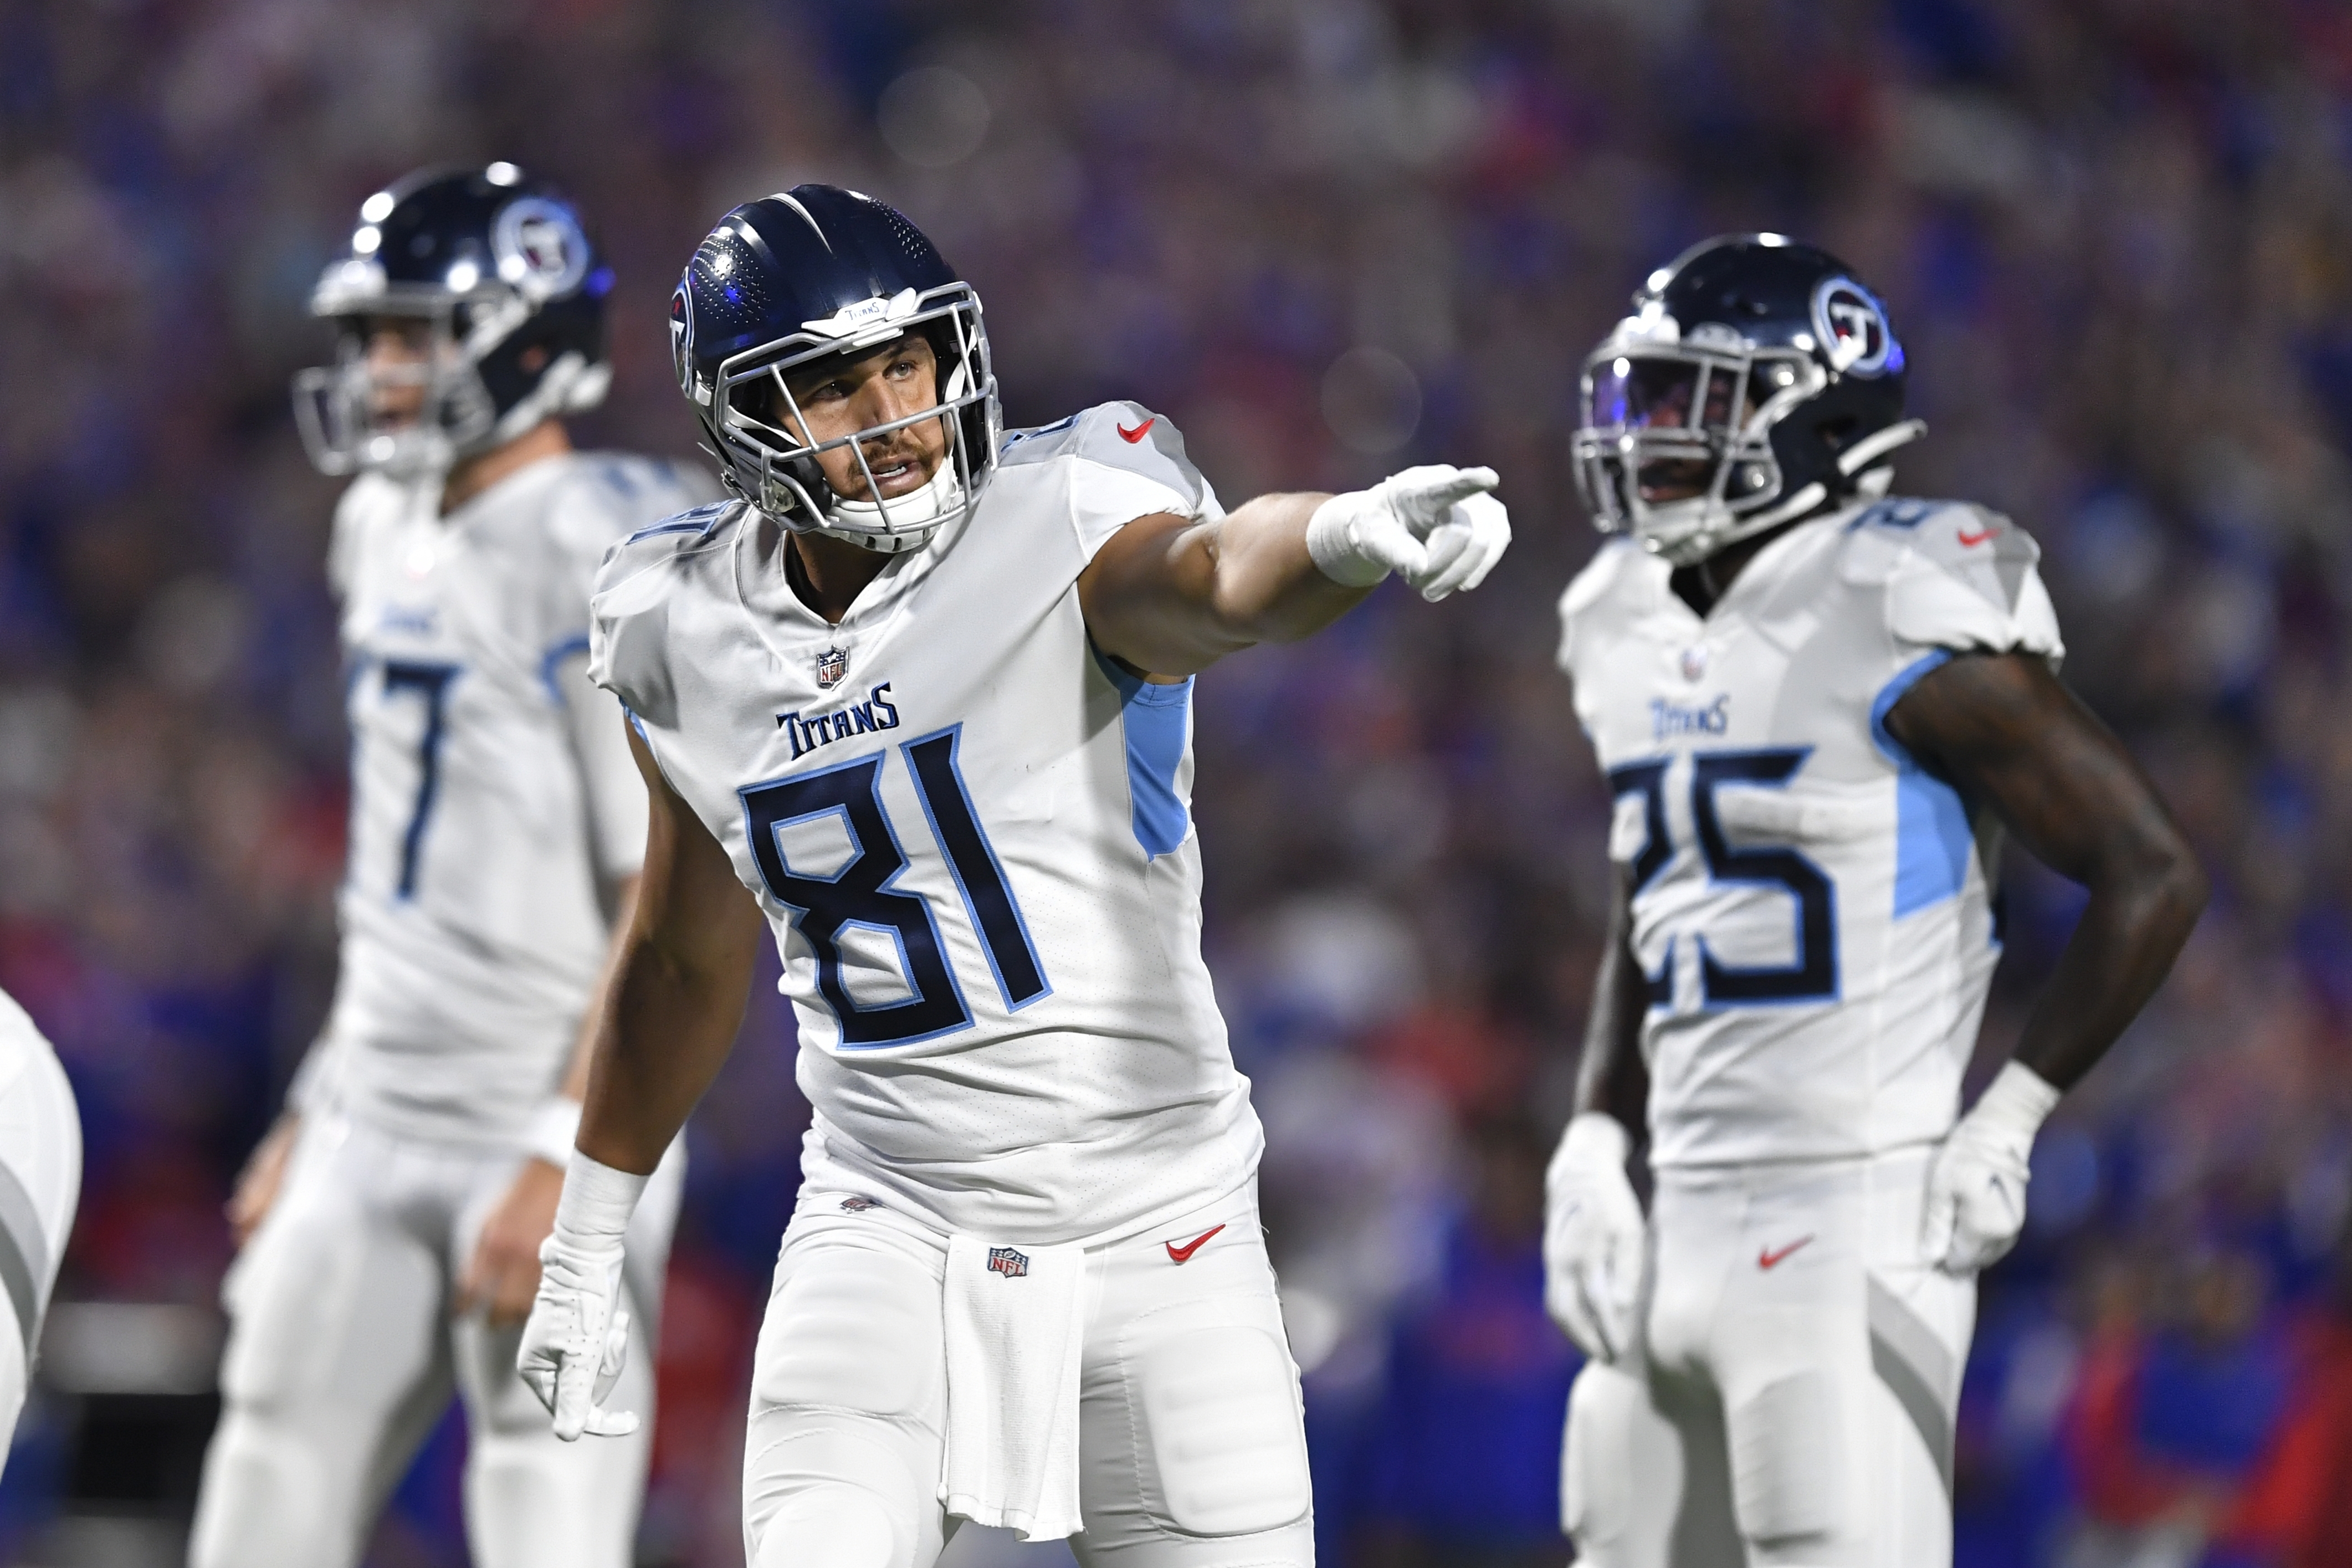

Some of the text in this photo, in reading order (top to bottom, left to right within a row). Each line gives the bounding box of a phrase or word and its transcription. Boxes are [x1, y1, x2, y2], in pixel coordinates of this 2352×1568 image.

[844, 302, 880, 320] TITANS
[821, 664, 842, 682] NFL
[776, 681, 900, 761] TITANS
[737, 721, 1054, 1051] 81
[1608, 744, 1843, 1012] 25
[991, 1257, 1024, 1275] NFL
